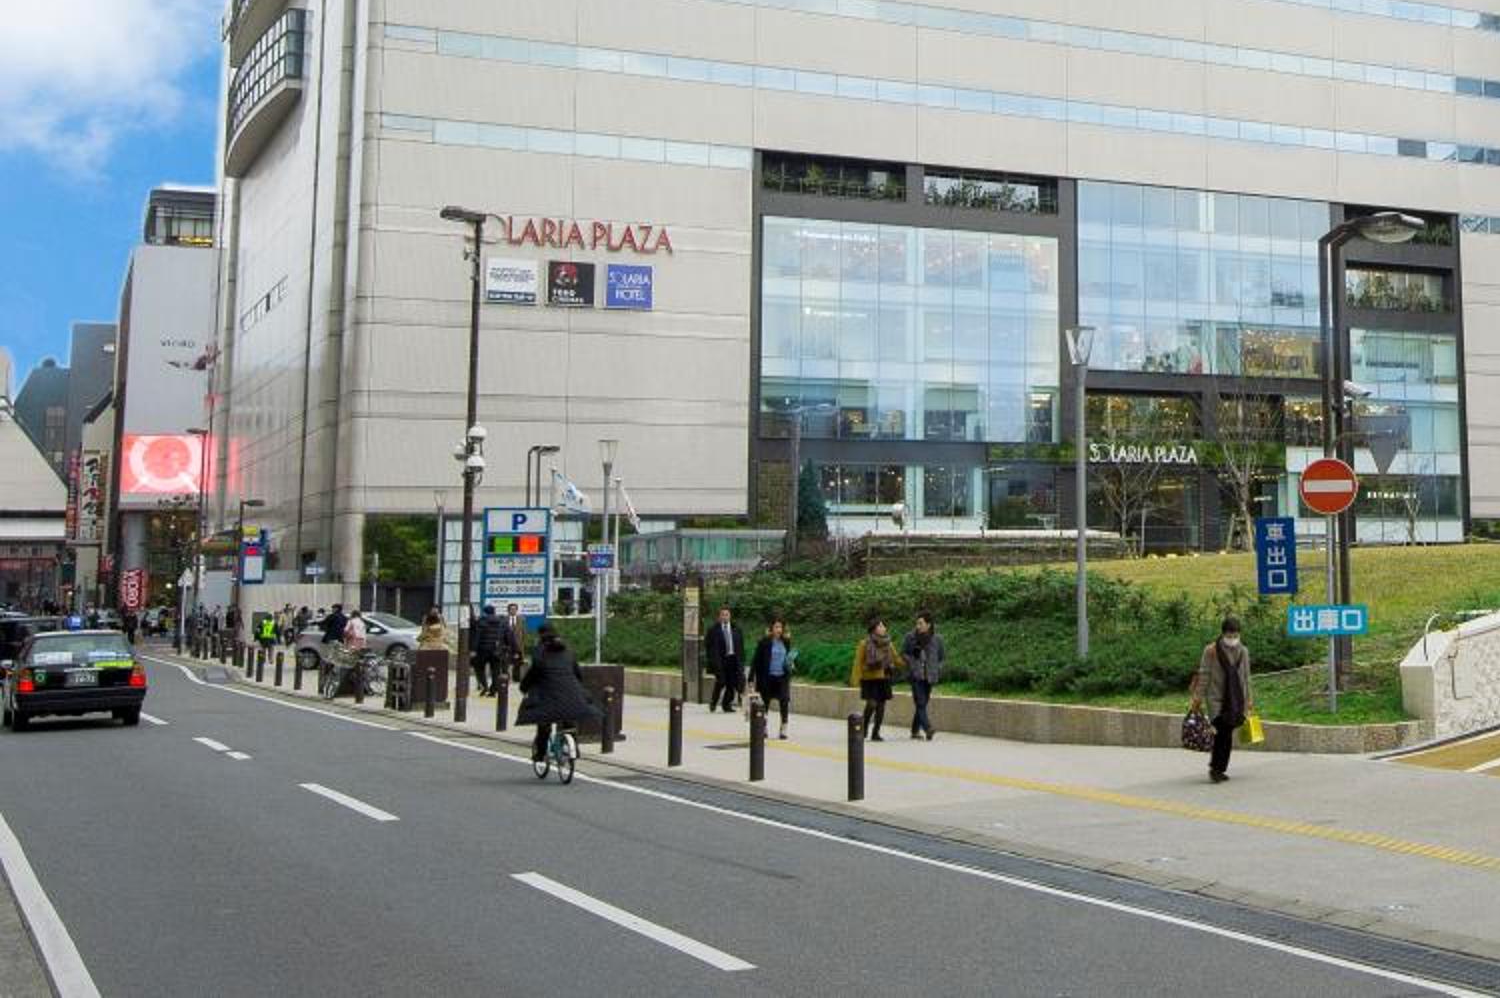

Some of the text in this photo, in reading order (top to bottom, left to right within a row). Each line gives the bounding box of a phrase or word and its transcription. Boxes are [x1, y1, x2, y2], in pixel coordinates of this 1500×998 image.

[463, 214, 673, 255] OLARIA PLAZA
[1089, 443, 1198, 465] SOLARIA PLAZA
[511, 513, 527, 531] P
[1265, 522, 1288, 588] 車出口
[1293, 608, 1363, 632] 出庫口
